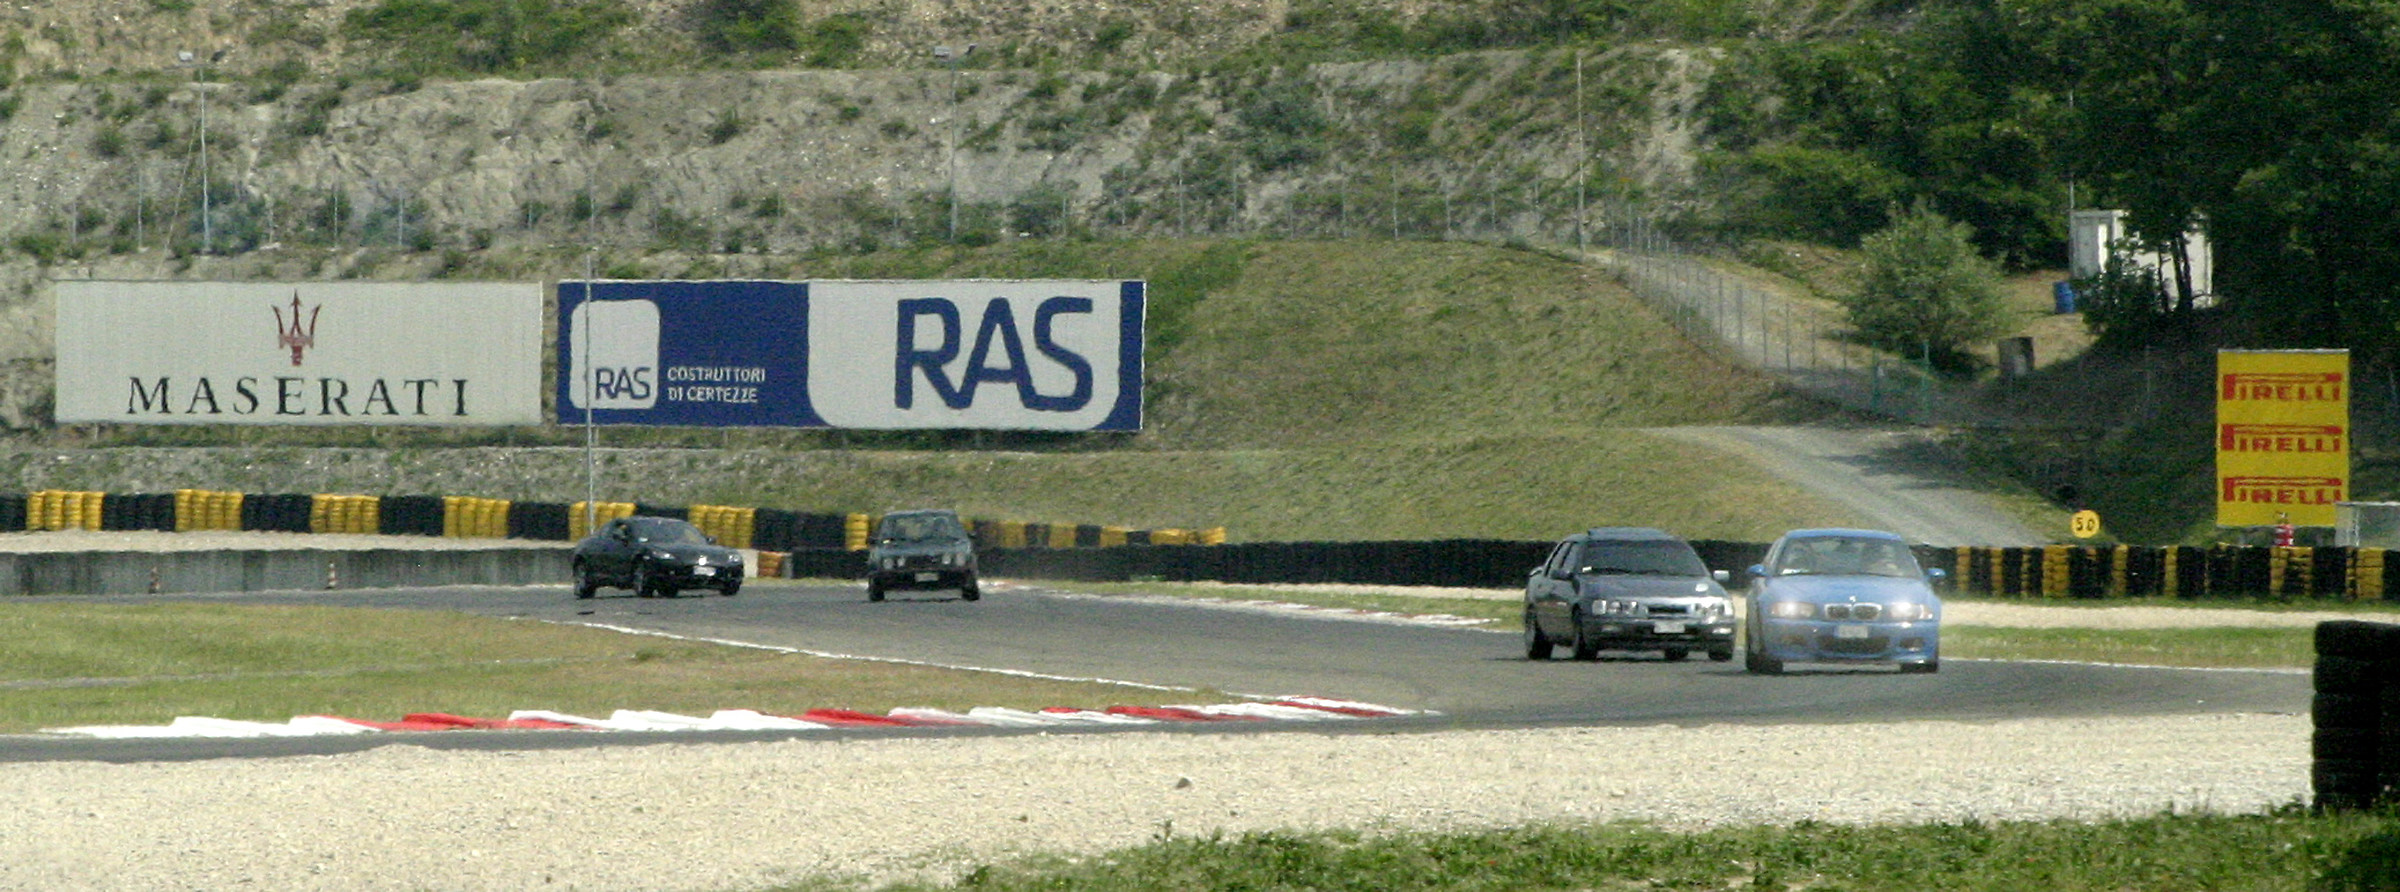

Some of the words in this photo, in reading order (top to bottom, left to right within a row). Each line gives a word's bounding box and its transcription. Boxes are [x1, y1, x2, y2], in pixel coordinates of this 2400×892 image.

[894, 296, 1094, 413] RAS
[594, 366, 651, 400] RAS
[667, 365, 767, 382] COSTRUTTORI
[2222, 373, 2342, 401] PIRELLI
[125, 376, 469, 416] MASERATI
[667, 387, 683, 401] DI
[686, 386, 759, 403] CERTEZZE
[2221, 423, 2343, 453] PIRELLI
[2222, 476, 2342, 505] PIRELLI
